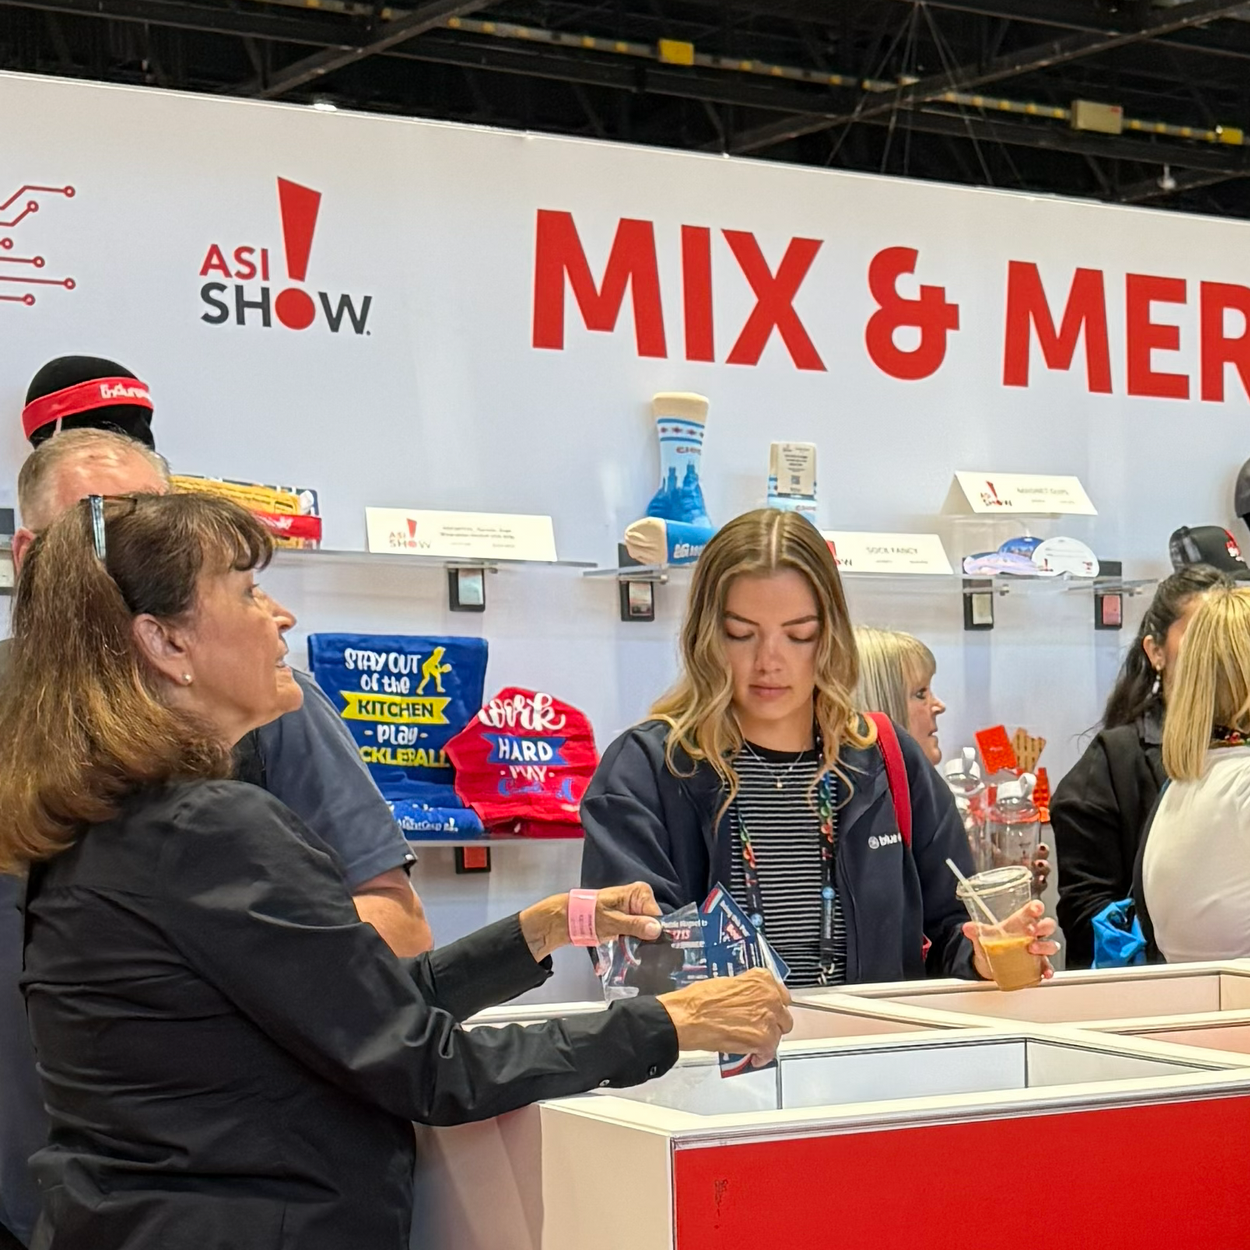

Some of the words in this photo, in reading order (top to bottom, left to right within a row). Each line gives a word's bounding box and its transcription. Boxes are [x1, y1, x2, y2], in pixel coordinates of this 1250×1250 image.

[200, 244, 270, 281] ASI
[532, 208, 828, 372] MIX
[864, 246, 960, 381] &
[200, 284, 371, 336] SHOW
[344, 648, 386, 672] STAY
[388, 652, 422, 674] OUT
[360, 674, 381, 691] of
[382, 676, 410, 694] the
[357, 699, 435, 718] KITCHEN
[376, 724, 418, 746] play
[359, 745, 450, 768] CKLEBALL
[498, 737, 553, 761] HARD
